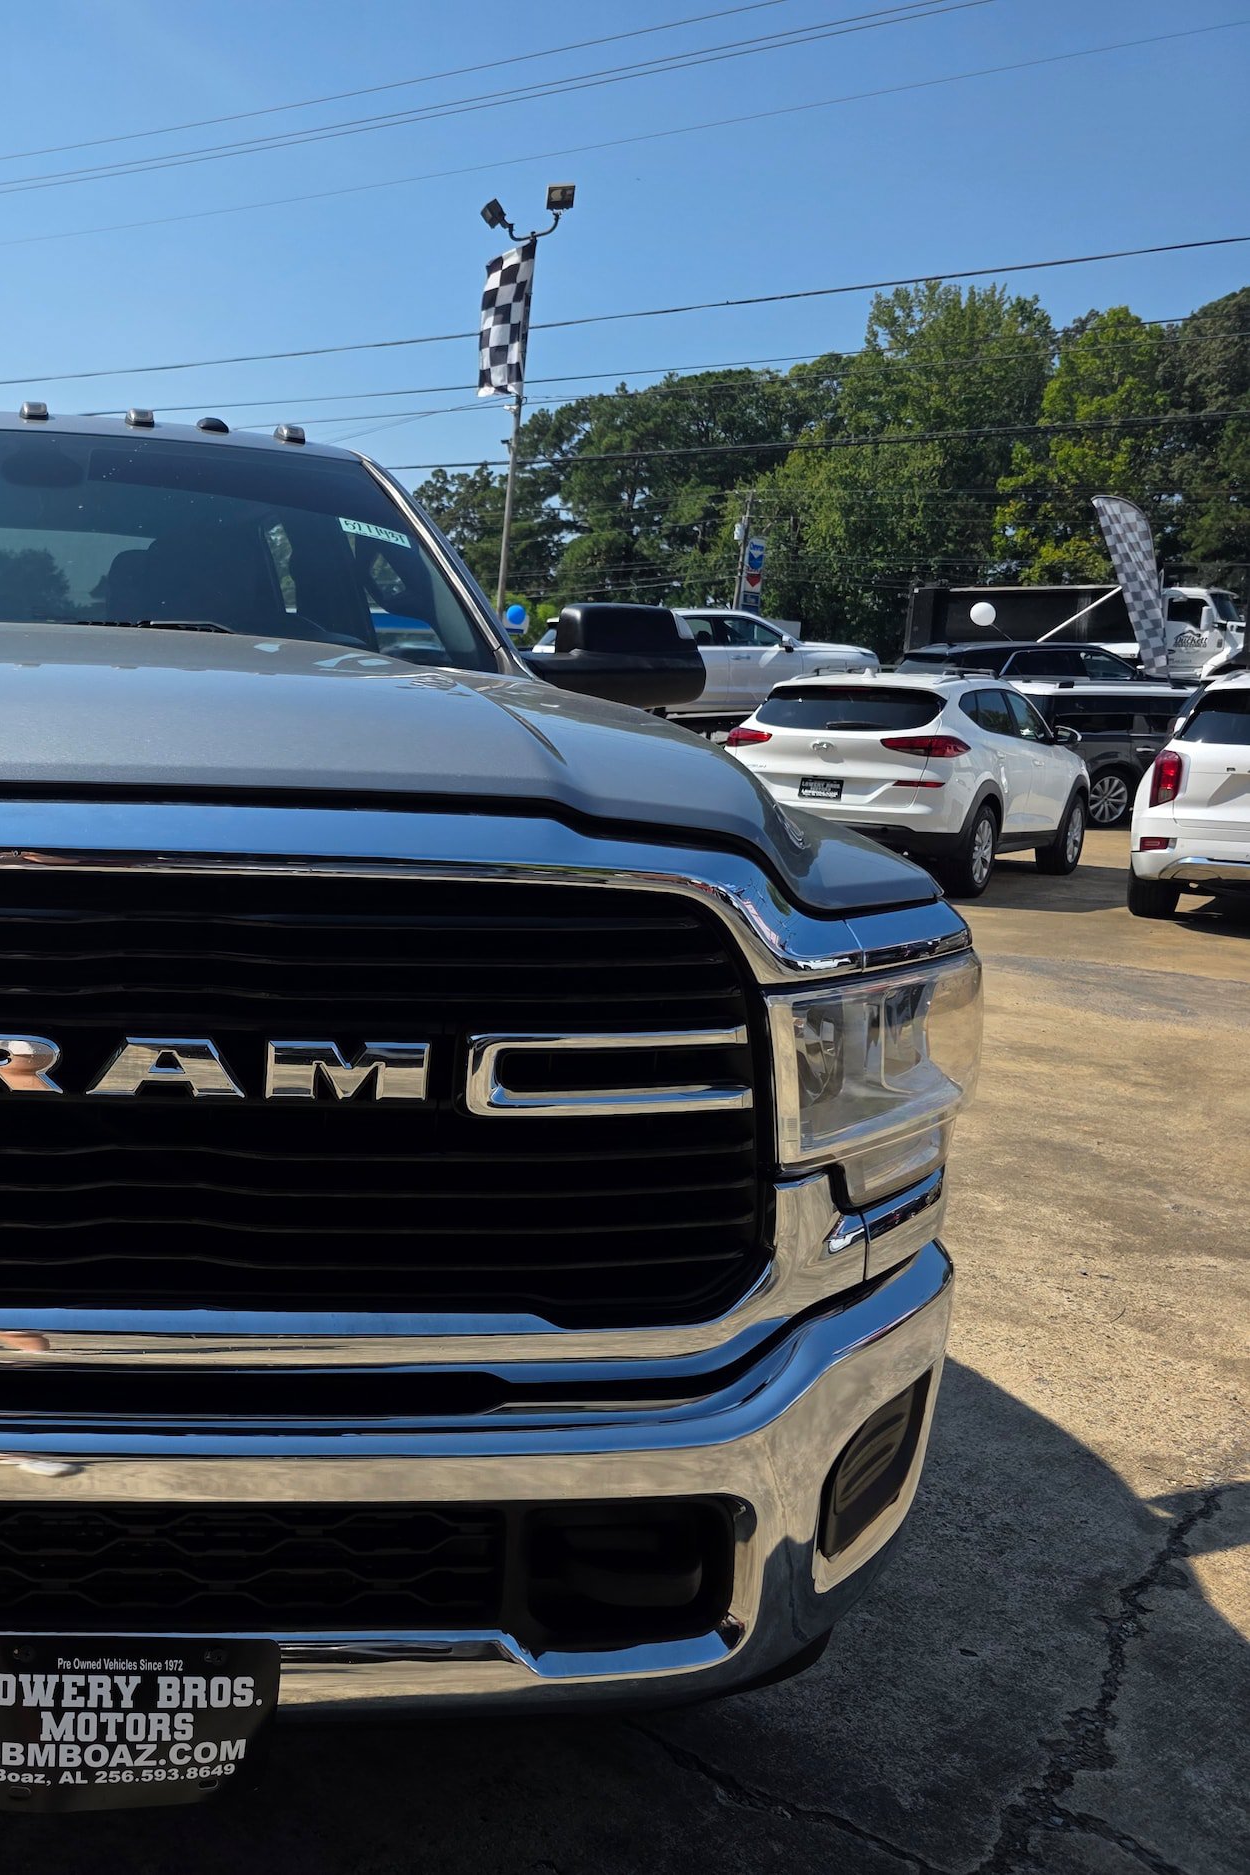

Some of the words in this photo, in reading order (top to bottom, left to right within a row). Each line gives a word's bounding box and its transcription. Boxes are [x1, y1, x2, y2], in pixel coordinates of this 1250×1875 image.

[57, 1657, 71, 1670] Pre
[73, 1658, 101, 1670] Owned
[103, 1658, 138, 1671] Vehicles
[140, 1659, 162, 1671] Since
[164, 1660, 183, 1672] 1972
[157, 1676, 263, 1709] BROS.
[40, 1711, 194, 1742] MOTORS
[59, 1770, 88, 1785] AL
[95, 1763, 236, 1783] 256.593.8649
